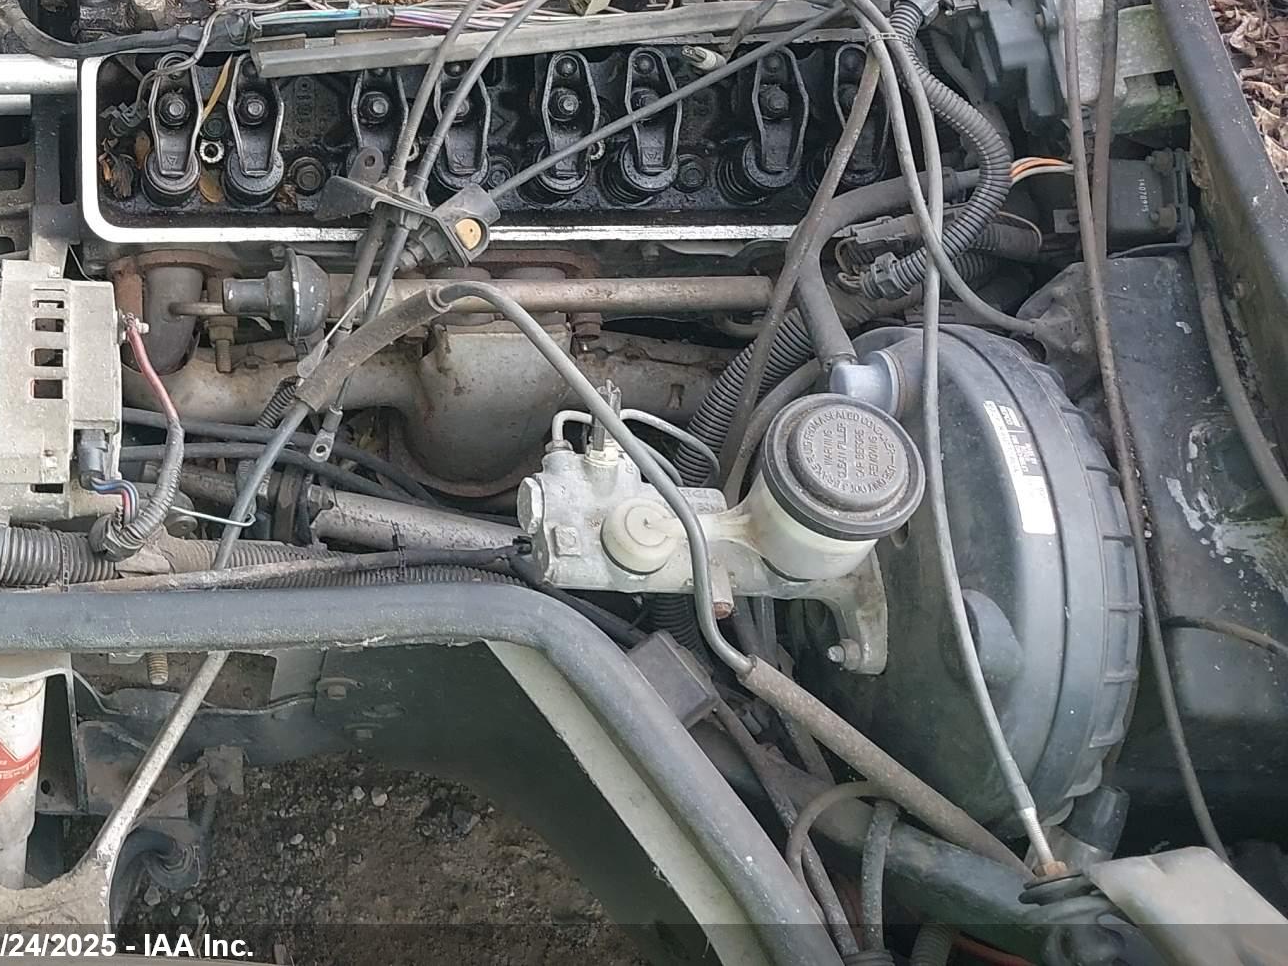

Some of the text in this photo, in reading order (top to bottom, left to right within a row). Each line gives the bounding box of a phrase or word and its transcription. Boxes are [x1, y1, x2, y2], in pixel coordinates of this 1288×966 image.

[824, 410, 860, 422] SEALED
[823, 430, 833, 466] WARNING
[836, 422, 848, 480] CLEAN FILLER
[854, 428, 865, 478] CAP BEFORE
[868, 435, 879, 477] REMOVING
